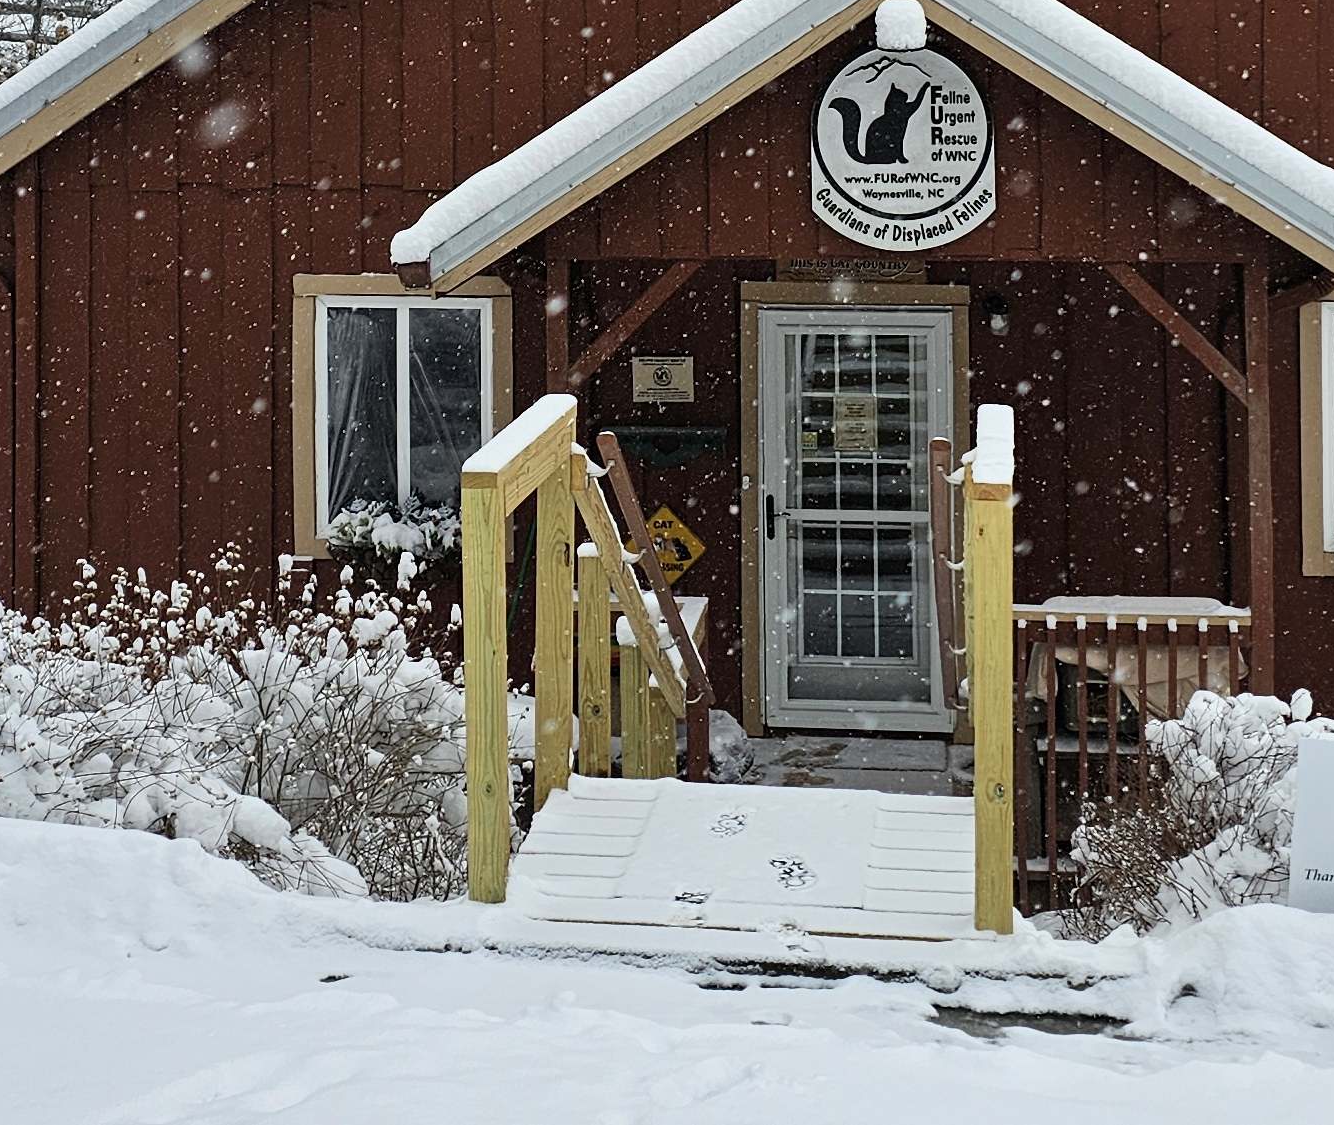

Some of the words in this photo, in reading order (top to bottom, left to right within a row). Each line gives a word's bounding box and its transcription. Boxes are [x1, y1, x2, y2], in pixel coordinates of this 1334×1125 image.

[930, 85, 971, 105] Feline
[930, 105, 976, 127] Urgent
[930, 126, 978, 146] Rescue
[931, 148, 944, 162] of
[944, 150, 977, 162] WNC
[844, 172, 961, 186] www.FURofWNC.org
[862, 188, 924, 201] Waynesville,
[927, 188, 945, 199] NC
[816, 188, 869, 235] Guardians
[873, 223, 890, 240] of
[892, 215, 955, 246] Displaced
[952, 188, 993, 226] Felines
[653, 520, 674, 529] CAT
